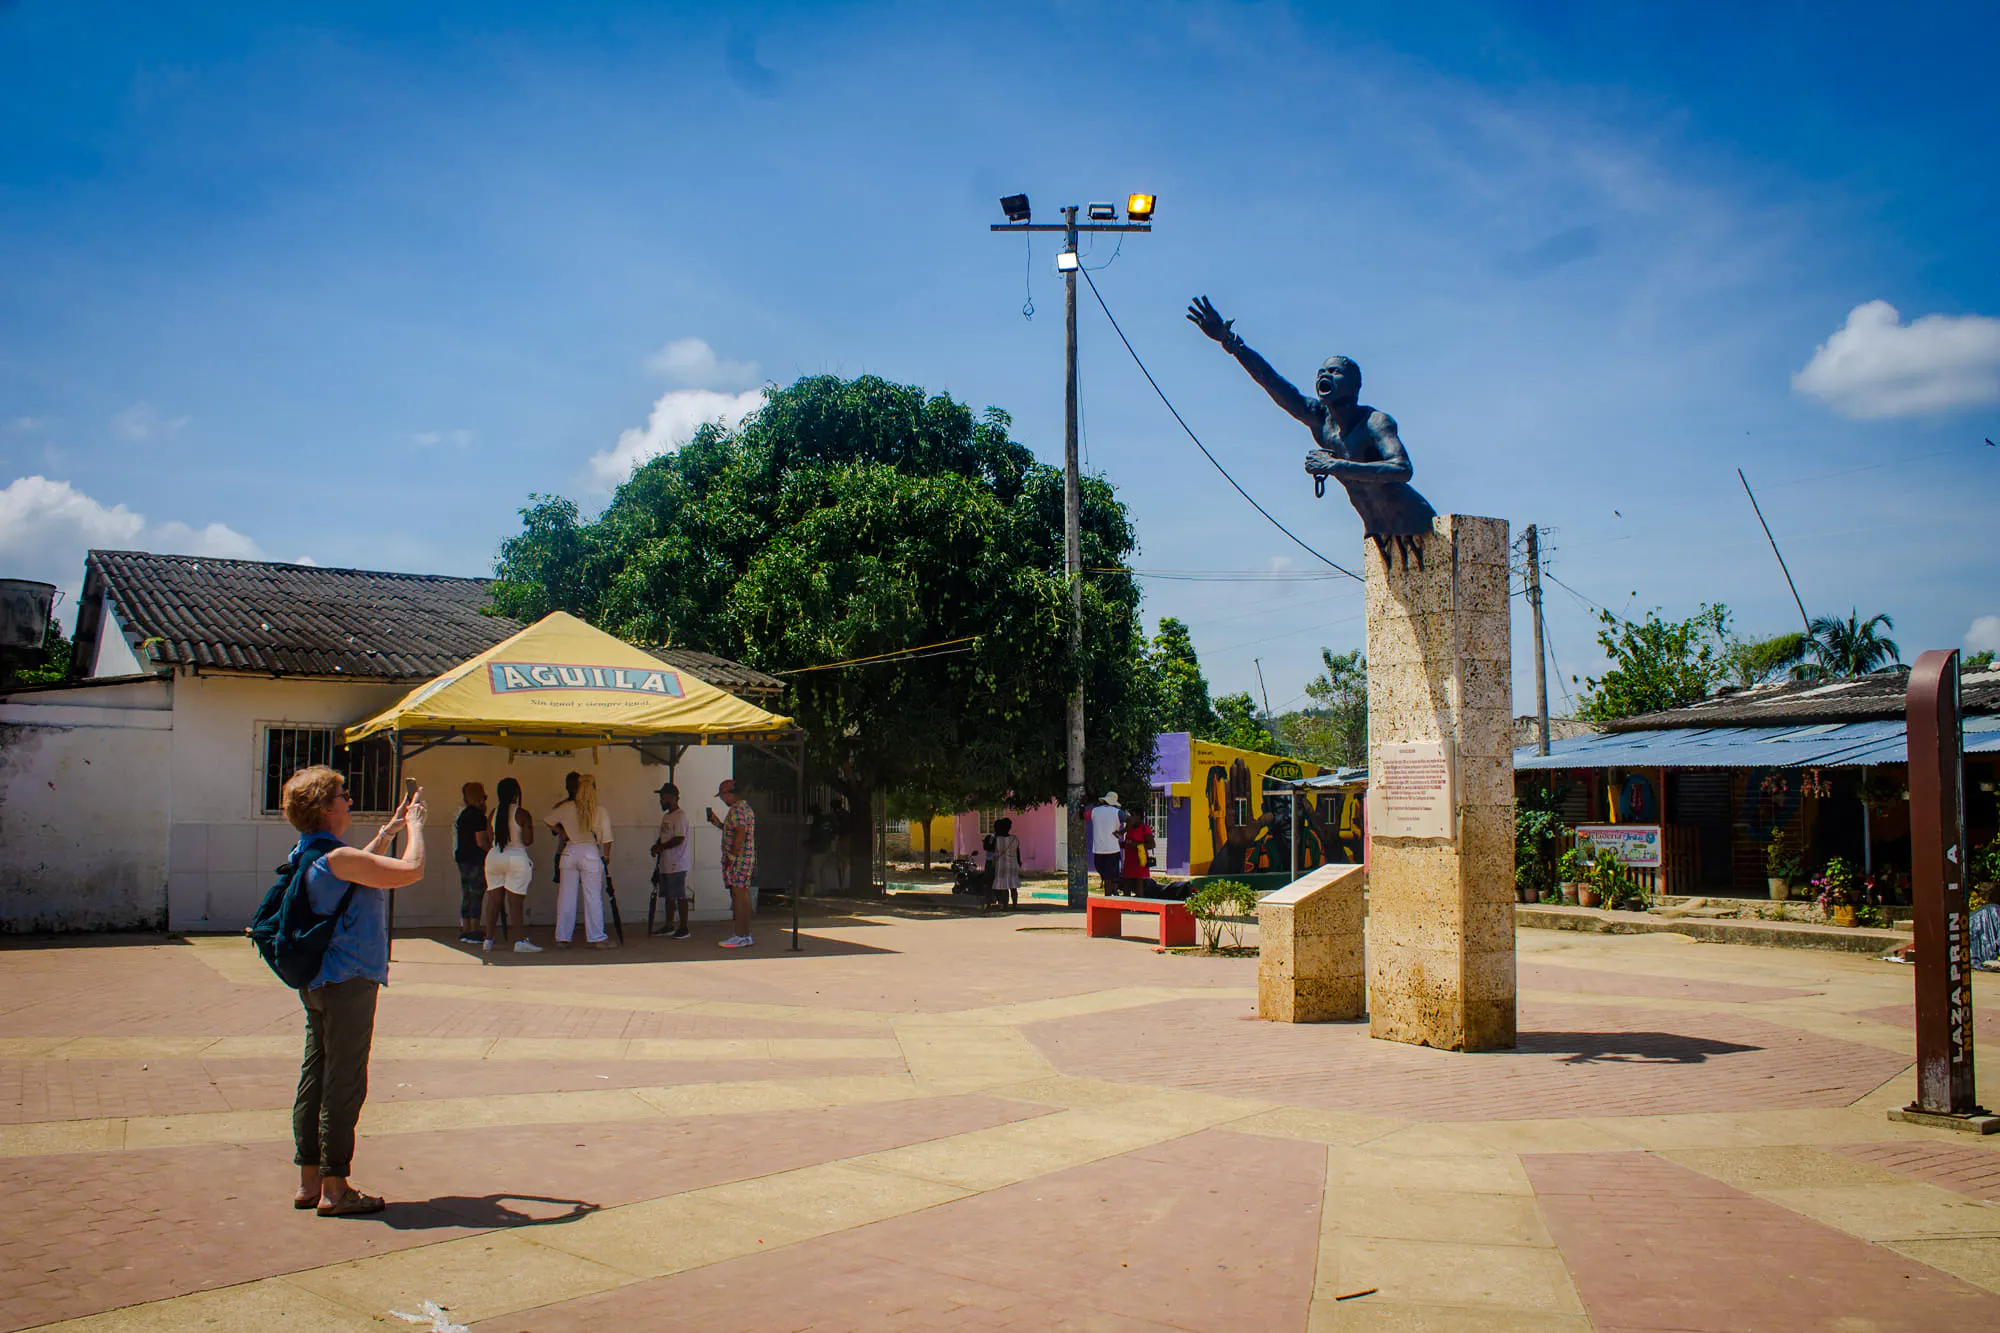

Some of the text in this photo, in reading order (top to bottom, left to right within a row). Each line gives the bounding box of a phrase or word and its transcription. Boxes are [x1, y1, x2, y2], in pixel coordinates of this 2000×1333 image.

[503, 666, 670, 694] AGUILA
[550, 700, 574, 708] igual
[586, 701, 621, 709] siempre
